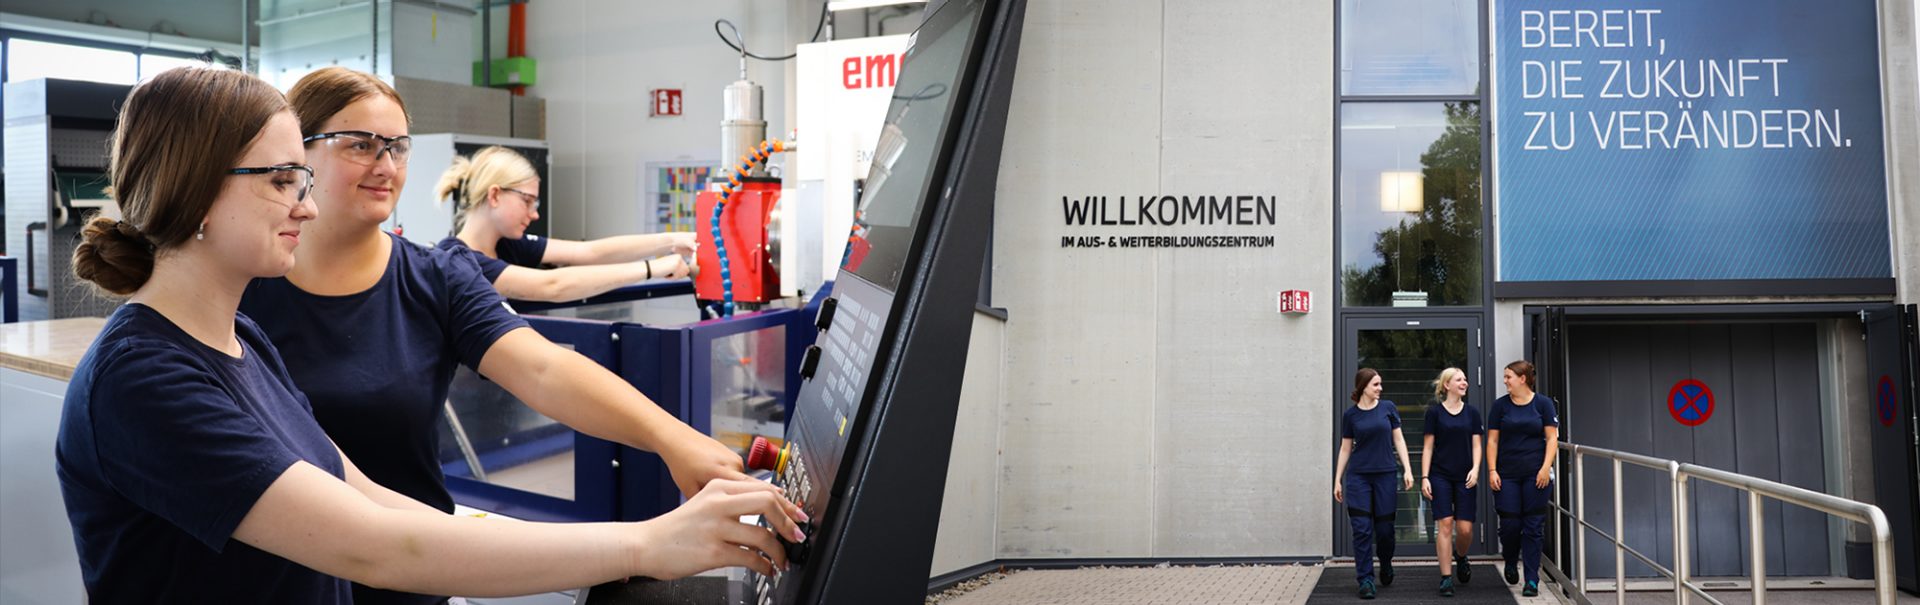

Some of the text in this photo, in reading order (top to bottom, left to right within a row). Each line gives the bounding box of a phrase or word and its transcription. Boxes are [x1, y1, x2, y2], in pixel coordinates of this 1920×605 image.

[1521, 9, 1665, 55] BEREIT,
[843, 52, 906, 90] em
[1522, 59, 1788, 98] DIE ZUKUNFT
[1524, 101, 1852, 150] ZU VERÄNDERN.
[1062, 195, 1276, 226] WILLKOMMEN
[1061, 236, 1275, 248] IM AUS- & WEITERBILDUNGSZENTRUM
